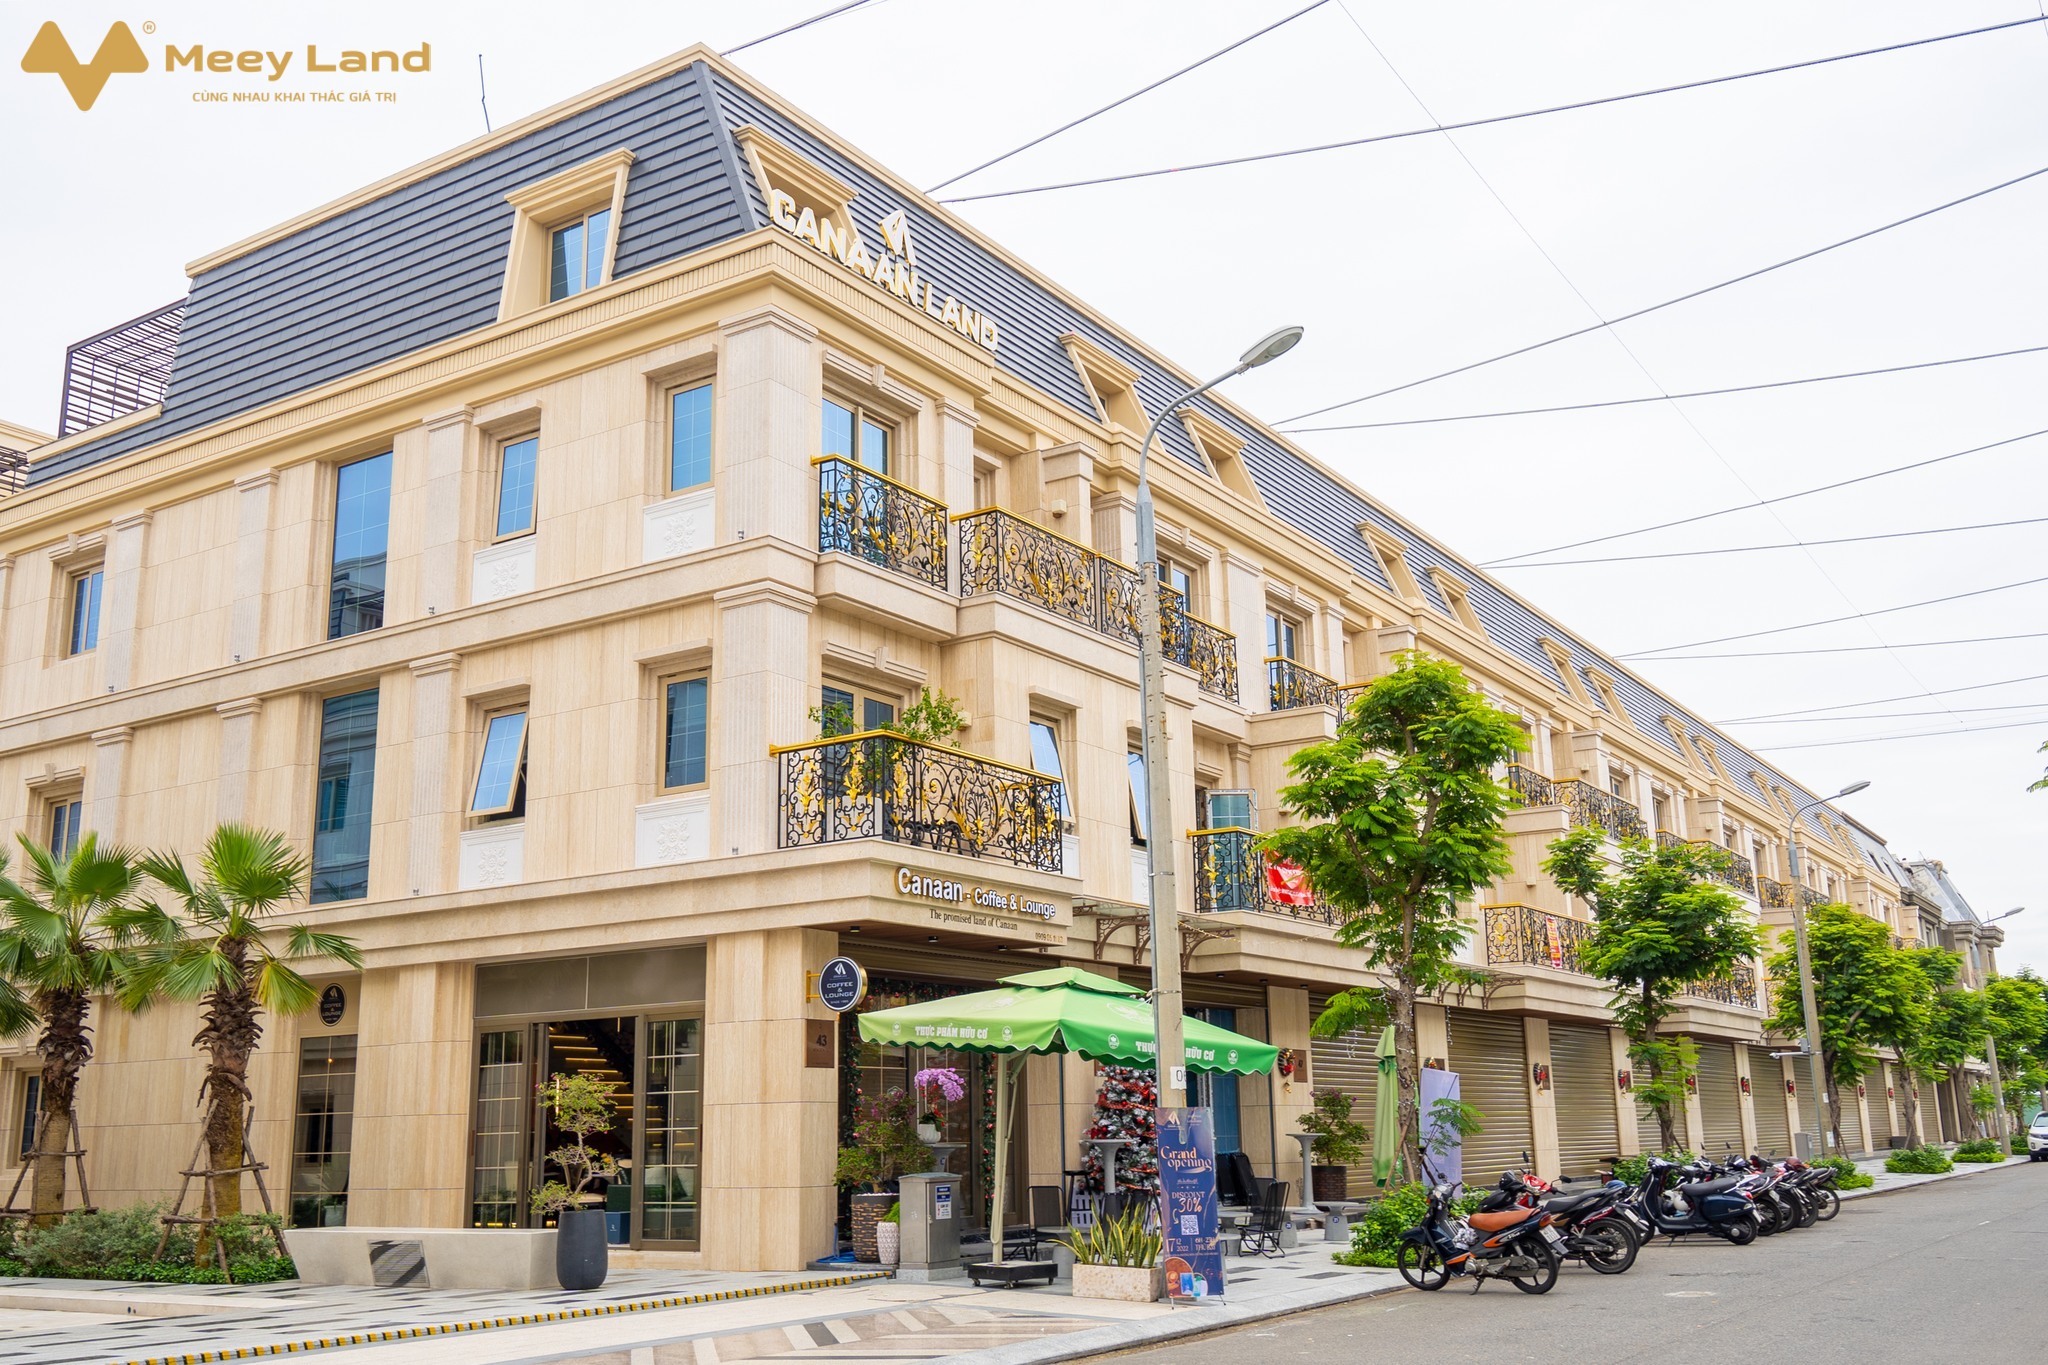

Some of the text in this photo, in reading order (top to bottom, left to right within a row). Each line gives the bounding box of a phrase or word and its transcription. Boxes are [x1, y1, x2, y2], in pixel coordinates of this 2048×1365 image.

[769, 188, 999, 352] CANAAN LAND
[896, 866, 963, 902] Canaan
[972, 887, 1008, 909] Coffee
[1009, 894, 1018, 910] &
[1019, 896, 1056, 920] Lounge
[929, 908, 1018, 931] The promised land of Canaan
[826, 981, 854, 989] COFFEE
[825, 991, 854, 999] LOUNGE
[915, 1022, 989, 1040] THỰC PHẨM HỮU CƠ
[816, 1033, 827, 1047] 43
[1203, 1049, 1215, 1061] CƠ
[1160, 1145, 1197, 1160] Grand
[1167, 1158, 1213, 1172] opening
[1178, 1197, 1202, 1213] 30%
